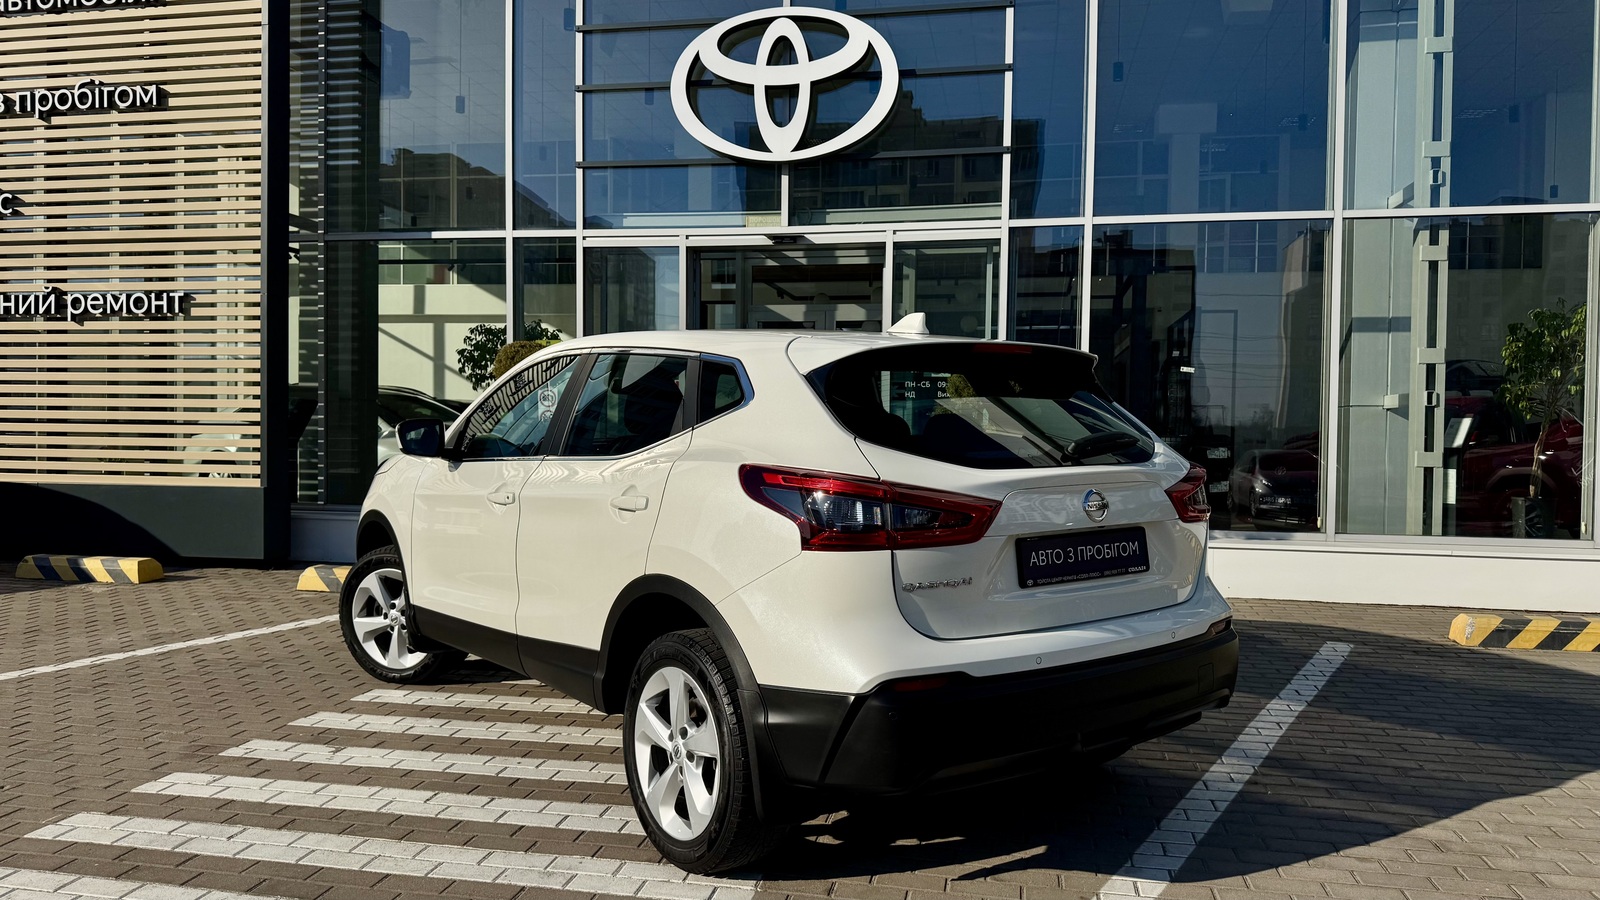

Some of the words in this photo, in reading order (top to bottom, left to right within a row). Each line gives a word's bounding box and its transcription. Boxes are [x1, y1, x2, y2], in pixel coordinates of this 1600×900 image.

[16, 79, 157, 119] пробігом
[0, 286, 56, 315] ний
[67, 292, 184, 322] ремонт
[1030, 549, 1064, 567] АВТО
[1077, 541, 1140, 561] ПРОБІГОМ
[901, 576, 973, 593] QASHQAI
